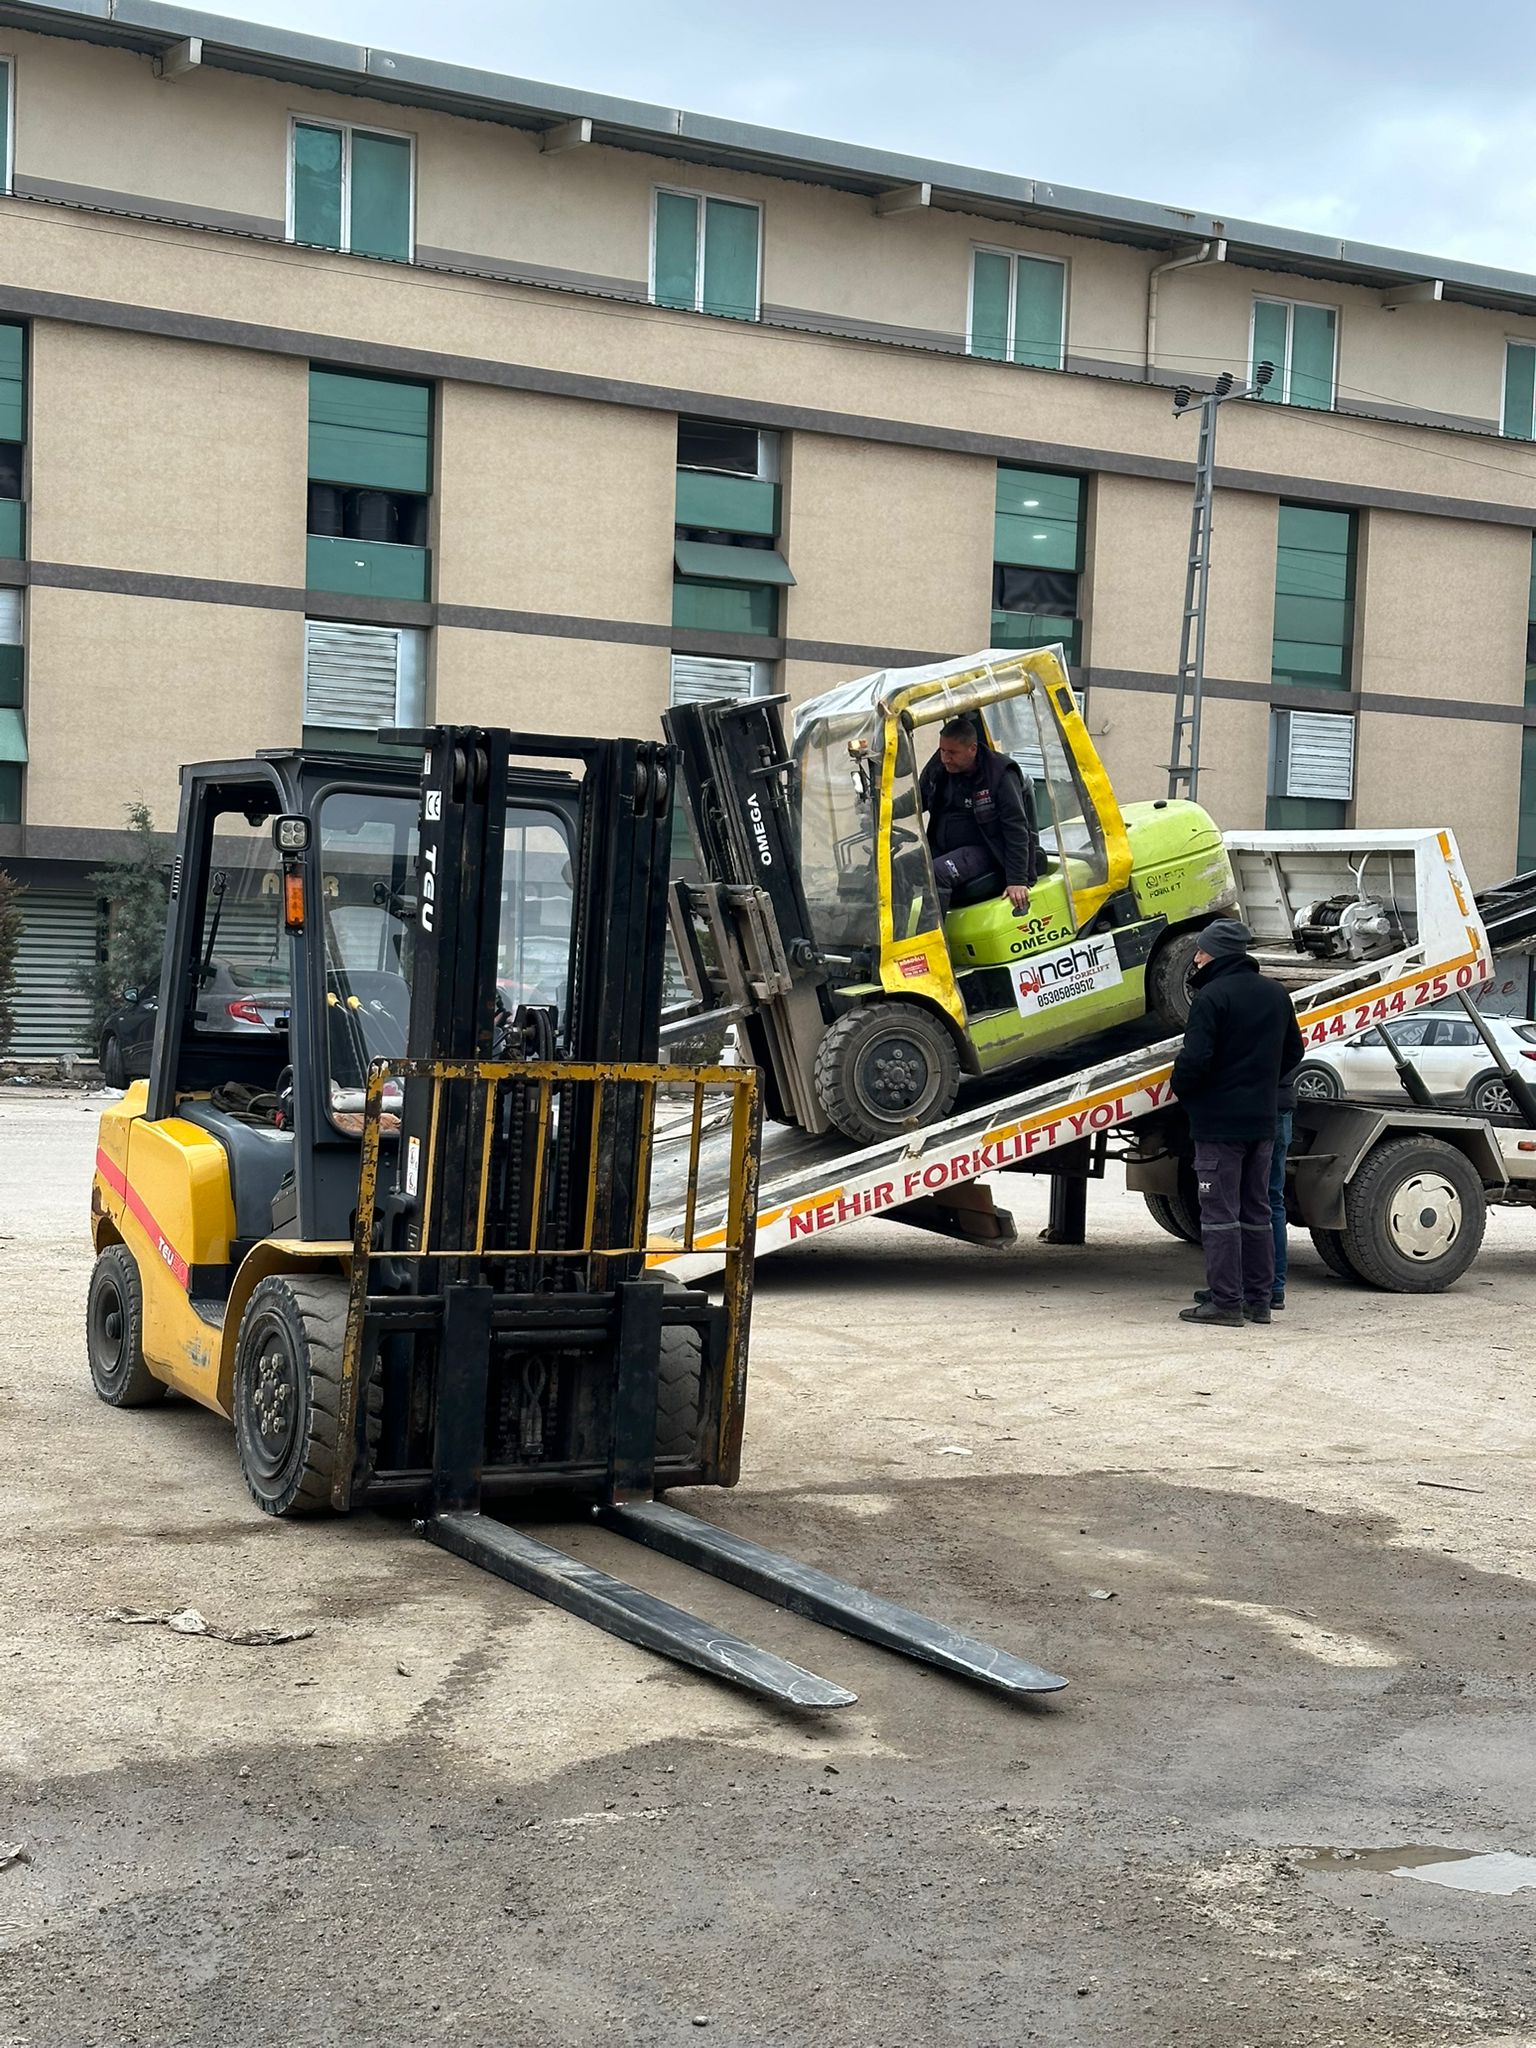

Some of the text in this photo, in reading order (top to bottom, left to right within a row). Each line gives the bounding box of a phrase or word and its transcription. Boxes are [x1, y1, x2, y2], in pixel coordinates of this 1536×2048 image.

[747, 792, 772, 866] OMEGA
[1010, 926, 1072, 954] OMEGA
[1038, 944, 1105, 985] nehir
[1070, 963, 1110, 982] FORKLIFT
[1037, 977, 1096, 1008] 05305059512
[904, 1121, 1062, 1198] FORKLIFT
[1068, 1097, 1133, 1137] YOL
[1354, 990, 1407, 1030] 244
[1414, 974, 1448, 1007] 25
